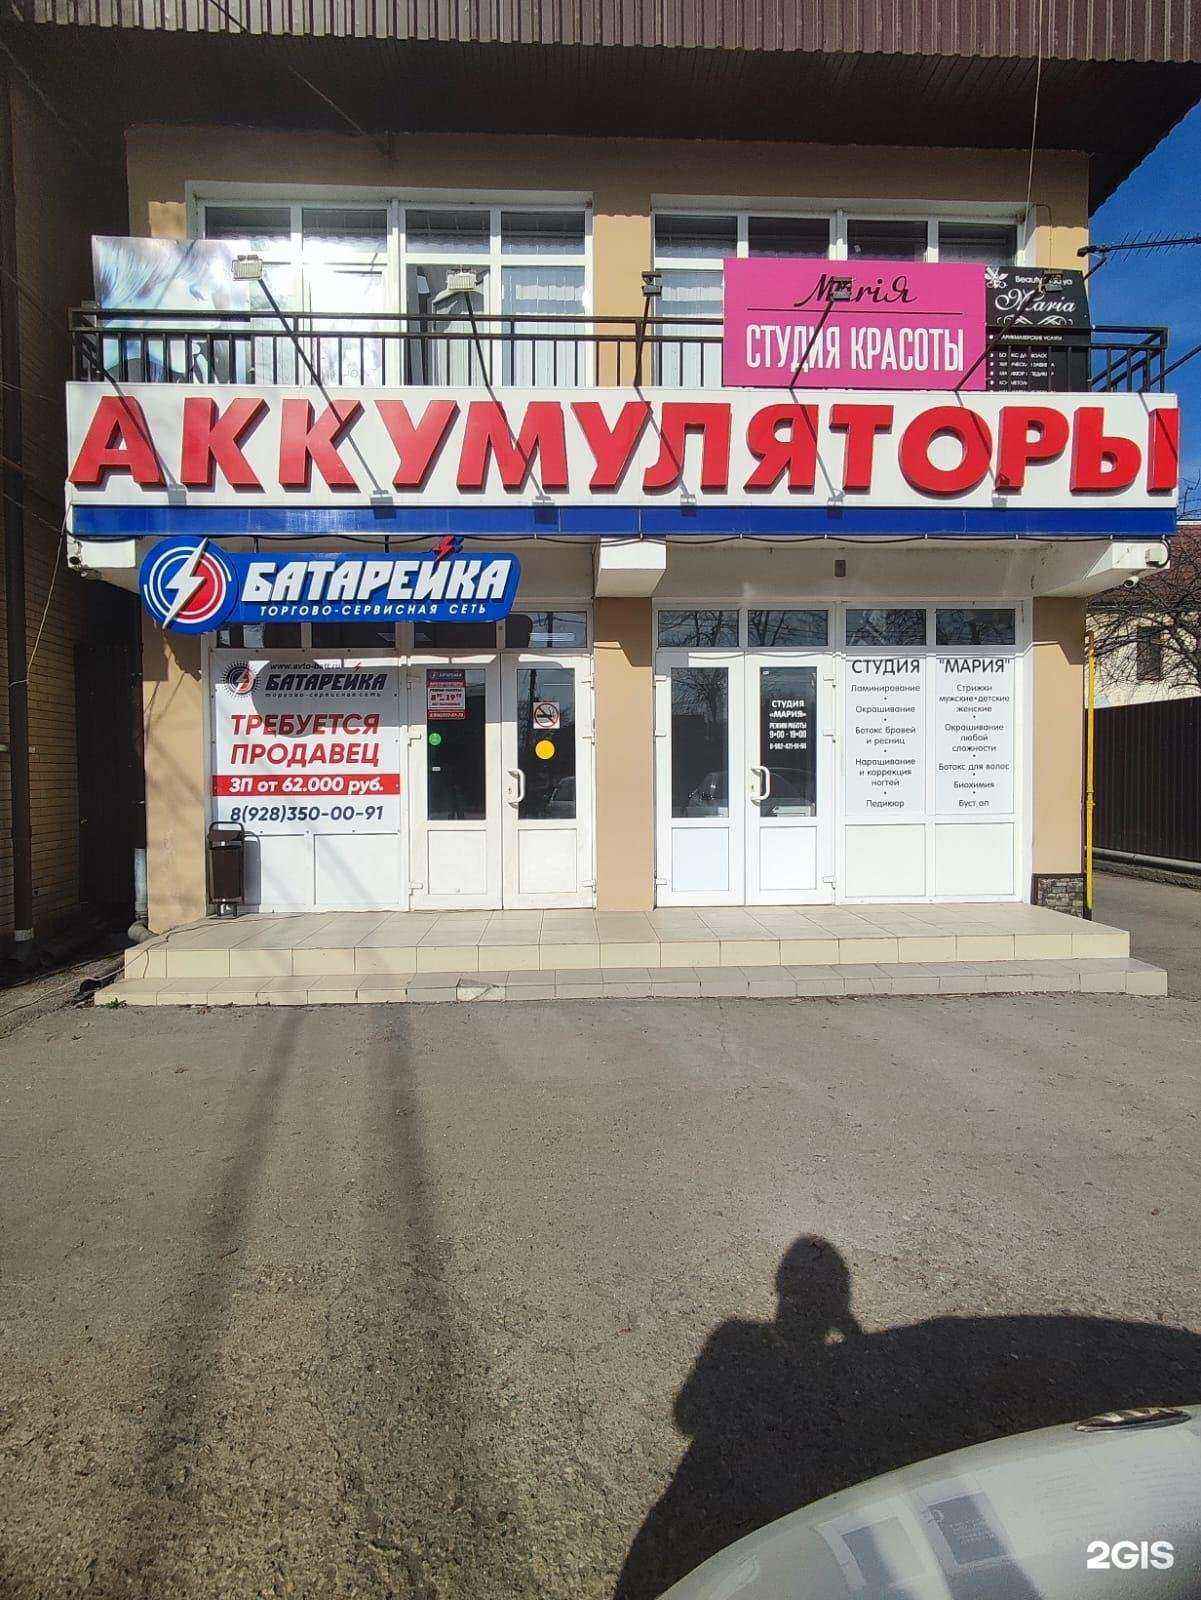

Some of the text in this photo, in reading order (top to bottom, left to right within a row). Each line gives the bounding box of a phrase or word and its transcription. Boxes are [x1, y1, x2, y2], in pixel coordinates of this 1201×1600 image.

[745, 324, 964, 373] СТУДИЯ КРАСОТЫ
[68, 395, 1179, 495] АККУМУЛЯТОРЫ
[241, 557, 512, 602] БАТАРЕЙКА
[260, 604, 486, 616] ТОРГОВО-СЕРВИСНАЯ СЕТЬ
[851, 659, 920, 675] СТУДИЯ
[939, 659, 1010, 673] "МАРИЯ"
[265, 670, 388, 691] БАТАРЕЙКА
[851, 684, 921, 693] Ламинирование
[771, 700, 805, 709] СТУДИЯ
[855, 705, 916, 713] Окрашивание
[230, 713, 381, 736] ТРЕБУЕТСЯ
[855, 726, 882, 734] Ботокс
[874, 738, 906, 746] ресниц
[960, 733, 989, 741] любой
[230, 743, 380, 768] ПРОДАВЕЦ
[938, 762, 966, 771] Ботокс
[229, 777, 384, 796] ЗП от 62.000 руб.
[866, 799, 905, 808] Педикюр
[230, 804, 385, 823] 8(928)350-00-91
